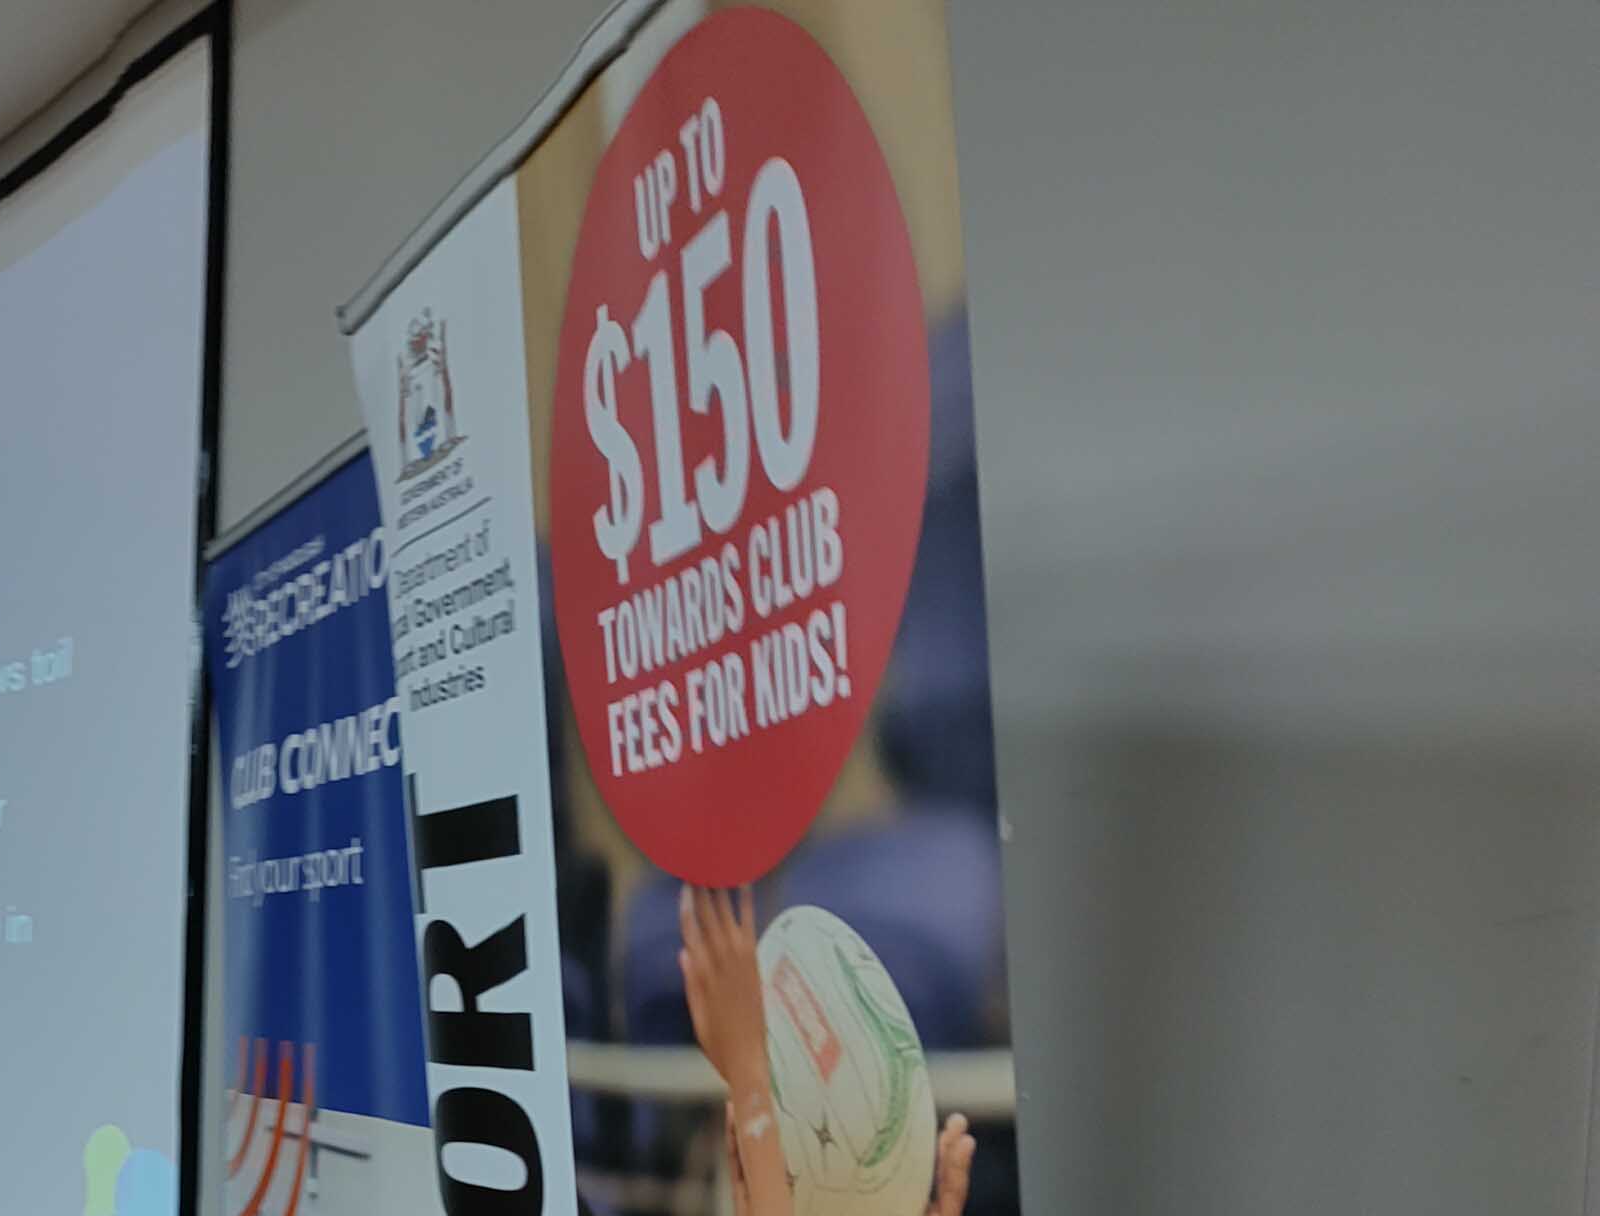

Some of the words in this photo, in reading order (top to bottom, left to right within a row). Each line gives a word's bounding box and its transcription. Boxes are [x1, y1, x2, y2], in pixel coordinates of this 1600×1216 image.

[633, 149, 677, 261] UP
[679, 97, 726, 213] TO
[582, 155, 821, 584] $150
[246, 526, 389, 656] RECREATIO
[418, 628, 446, 662] and
[449, 597, 517, 656] Cultural
[597, 540, 745, 685] TOWARDS
[748, 486, 845, 621] CLUB
[30, 635, 74, 686] toil
[606, 677, 681, 778] FEES
[685, 650, 750, 753] FOR
[751, 601, 852, 726] KIDS!
[231, 742, 278, 810] CLUB
[279, 695, 401, 795] CONNEC
[3, 904, 34, 944] in
[253, 855, 301, 908] your
[302, 836, 365, 903] sport
